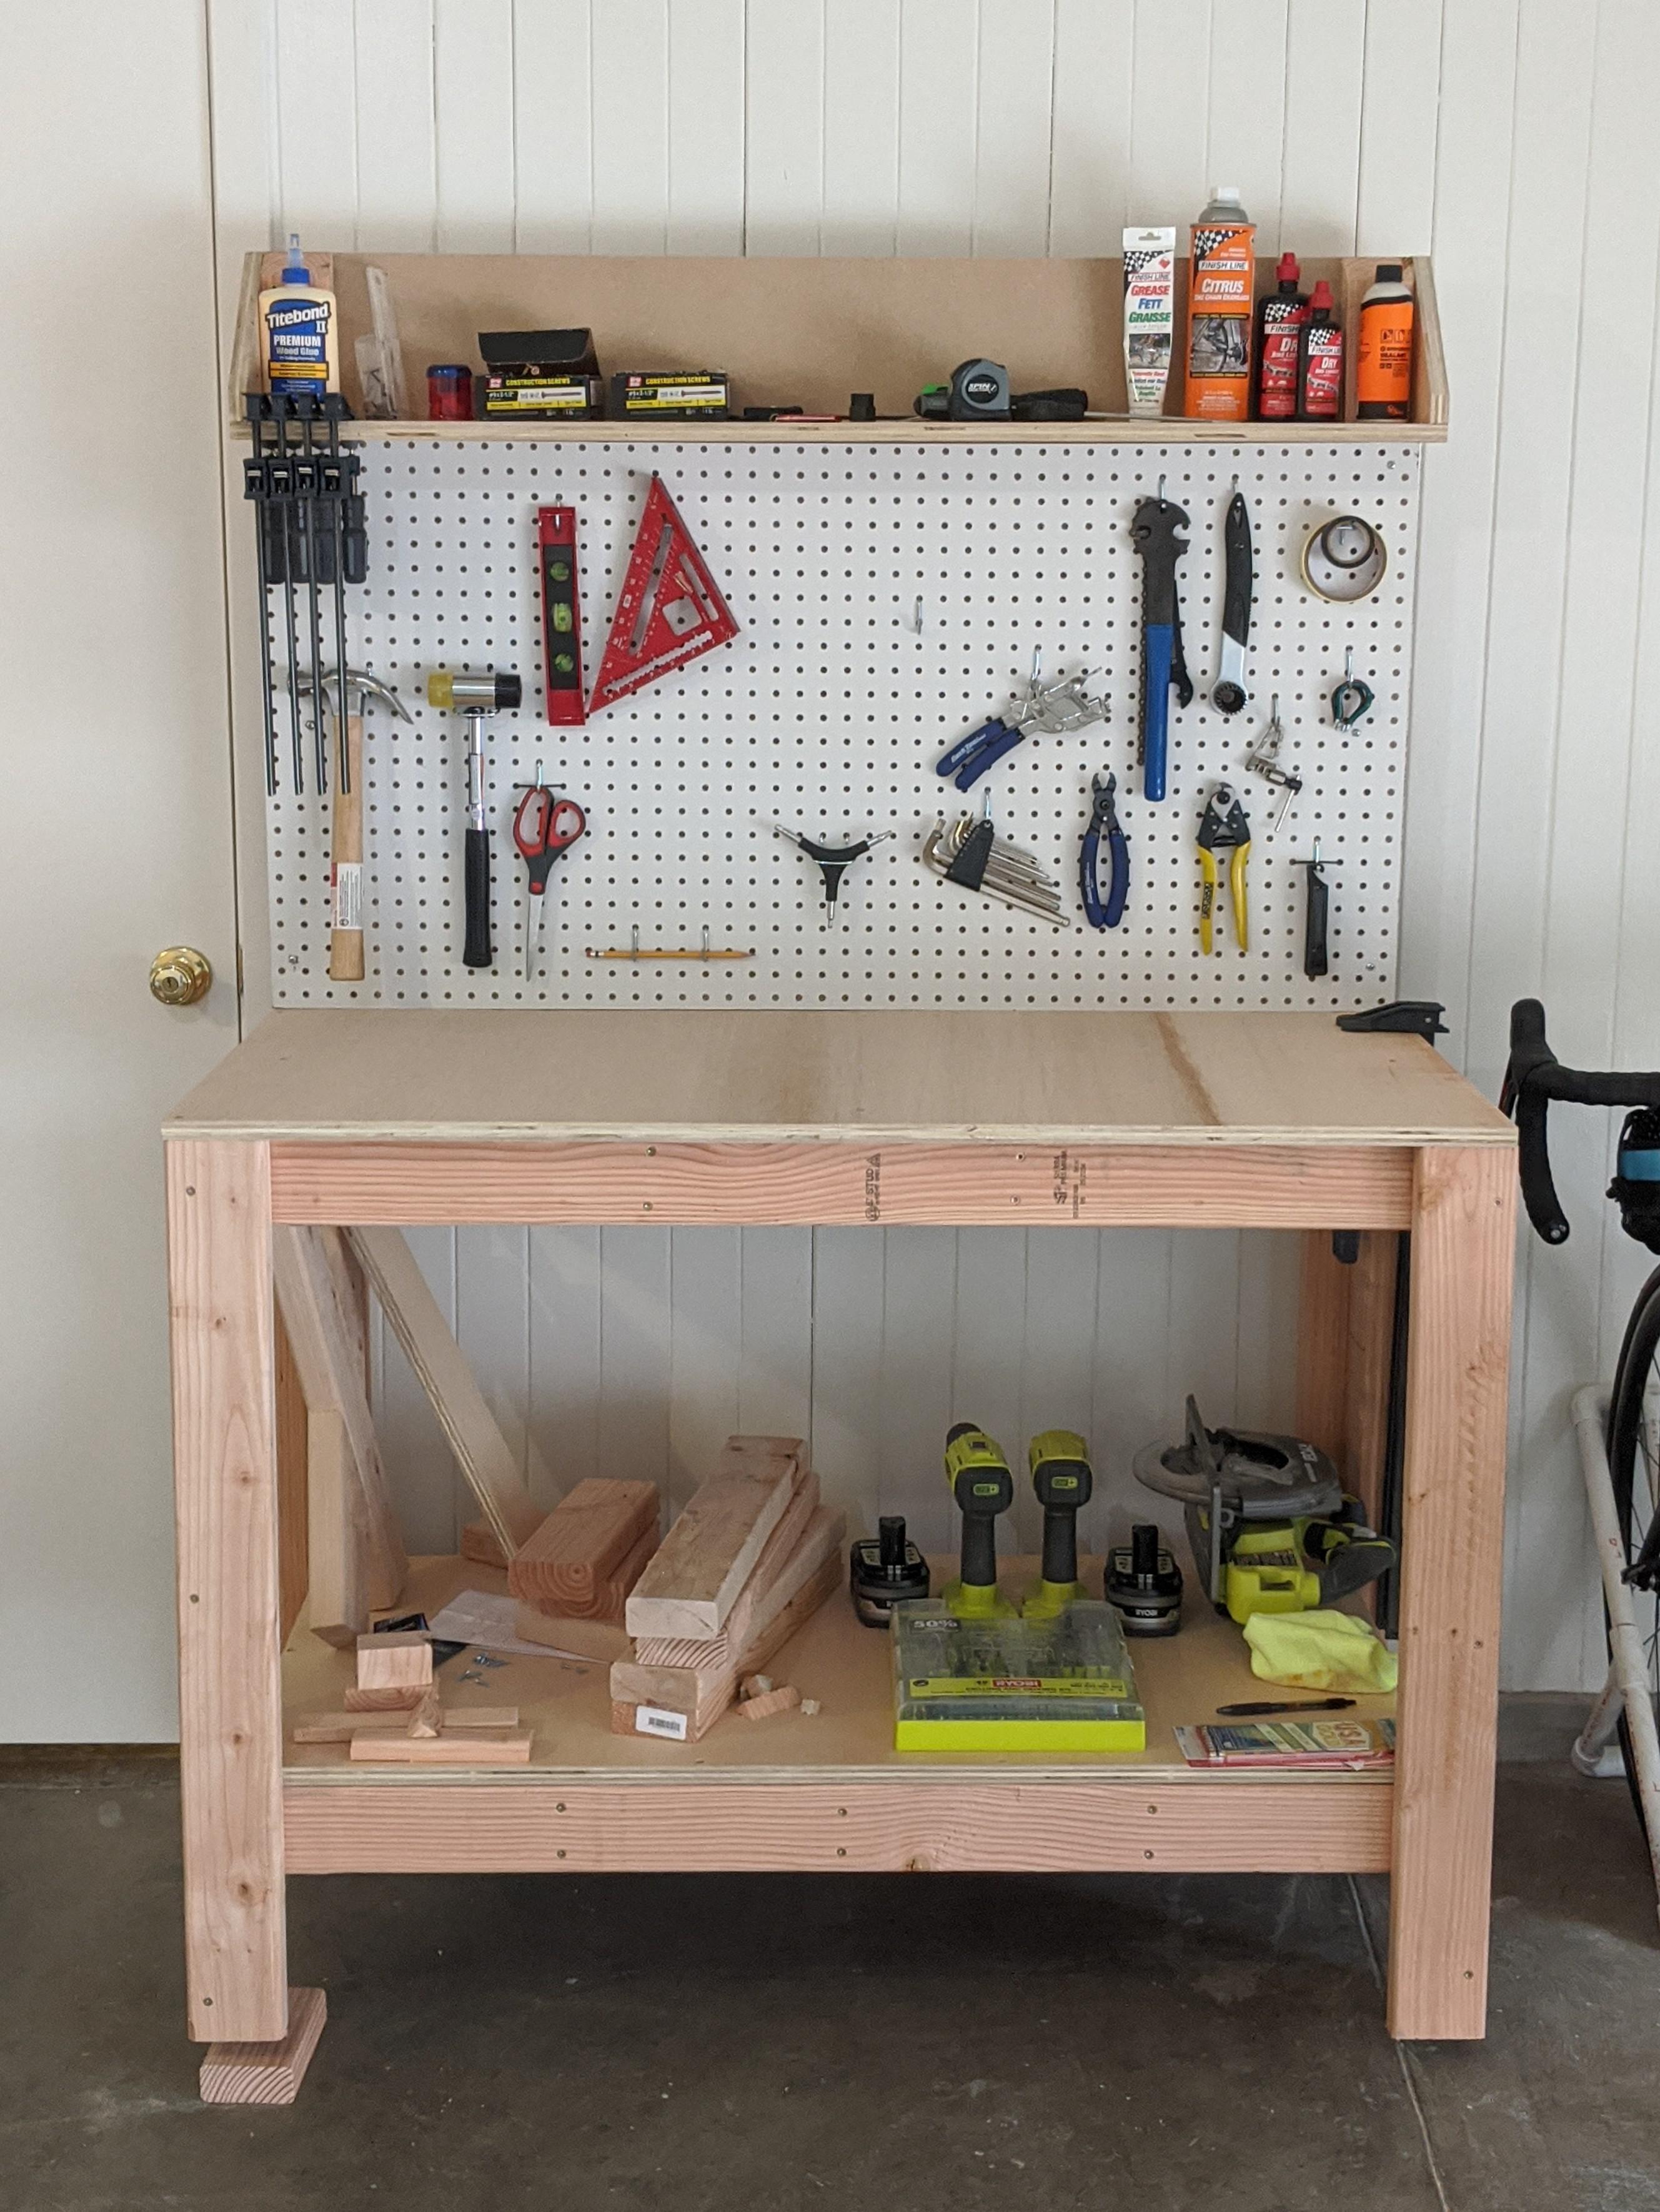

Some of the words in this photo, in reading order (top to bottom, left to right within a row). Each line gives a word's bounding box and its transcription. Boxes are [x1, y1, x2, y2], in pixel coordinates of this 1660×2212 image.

[1201, 261, 1228, 269] FINISH
[1131, 285, 1170, 296] GREASE
[1202, 278, 1244, 293] CITRUS
[1138, 298, 1163, 309] FETT
[267, 303, 329, 329] Titebond
[1129, 312, 1171, 323] GRAISSE
[316, 320, 326, 333] II
[273, 335, 321, 347] PREMIUM
[276, 347, 299, 355] Wood
[300, 347, 319, 356] Glue
[1321, 357, 1338, 369] DRY
